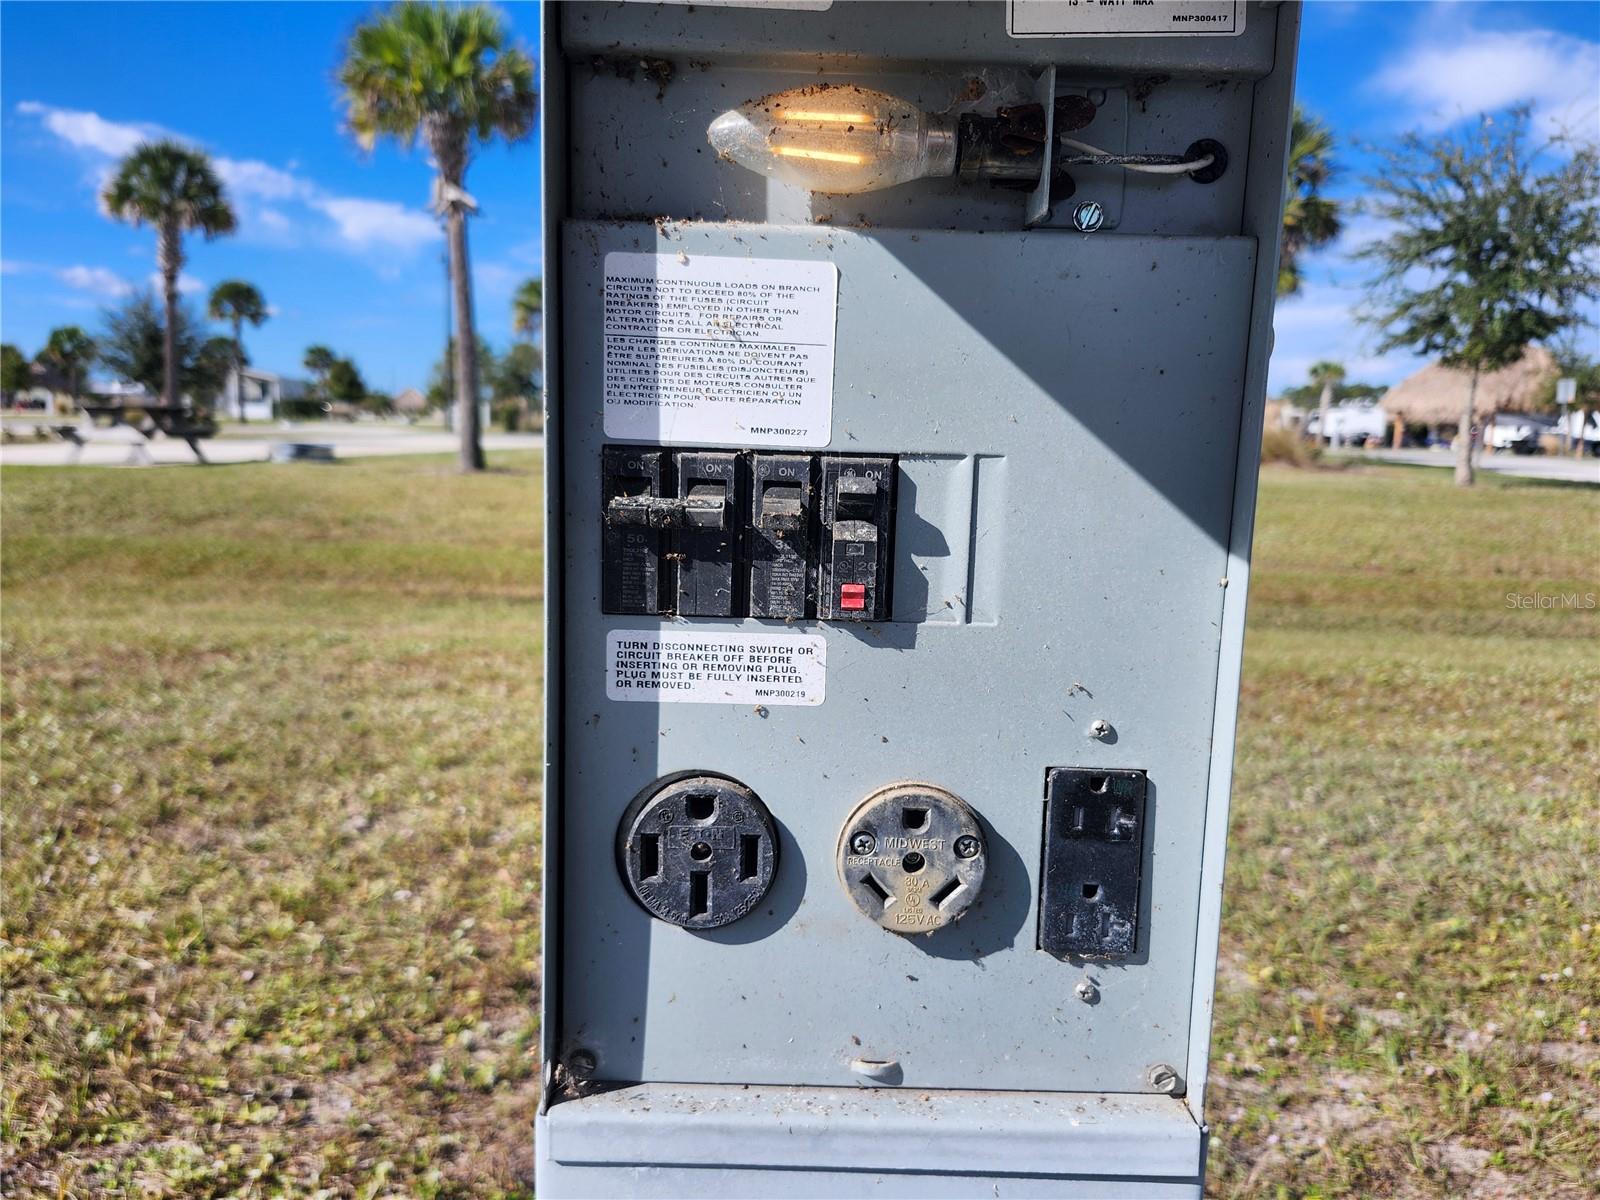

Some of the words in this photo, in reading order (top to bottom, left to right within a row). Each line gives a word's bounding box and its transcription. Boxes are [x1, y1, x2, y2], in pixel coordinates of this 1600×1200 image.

[1171, 14, 1228, 22] MNP300417
[657, 279, 721, 287] CONTINUOUS
[606, 292, 649, 300] RATINGS
[606, 300, 663, 309] BREAKERS)
[606, 316, 674, 324] ALTERATIONS
[606, 324, 673, 332] CONTRACTOR
[680, 340, 736, 348] CONTINUES
[660, 347, 724, 355] DÉRIVATIONS
[636, 354, 704, 362] SUPÉRIEURES
[728, 366, 808, 375] (DISJONCTEURS)
[624, 384, 702, 393] ENTREPRENEUR
[706, 388, 768, 396] ÉLECTRICIEN
[607, 391, 670, 399] ÉLECTRICIEN
[739, 396, 800, 405] RÉPARATION
[751, 427, 808, 436] MNP300227
[628, 460, 644, 470] ON
[705, 464, 722, 473] ON
[778, 468, 795, 477] ON
[864, 470, 882, 480] ON
[617, 641, 647, 650] TURN
[653, 642, 744, 652] DISCONNECTING
[750, 646, 793, 654] SWITCH
[617, 651, 661, 659] CIRCUIT
[667, 653, 718, 661] BREAKER
[724, 654, 744, 662] OFF
[749, 656, 792, 664] BEFORE
[616, 661, 677, 669] INSERTING
[703, 663, 762, 672] REMOVING
[616, 670, 646, 678] PLUG
[707, 673, 742, 682] FULLY
[747, 675, 802, 683] INSERTED
[616, 680, 631, 688] OR
[637, 681, 695, 689] REMOVED.
[884, 837, 946, 850] MIDWEST
[846, 857, 901, 867] RECEPTACLE
[922, 879, 930, 888] A
[896, 914, 924, 925] 125V
[926, 915, 942, 926] AC
